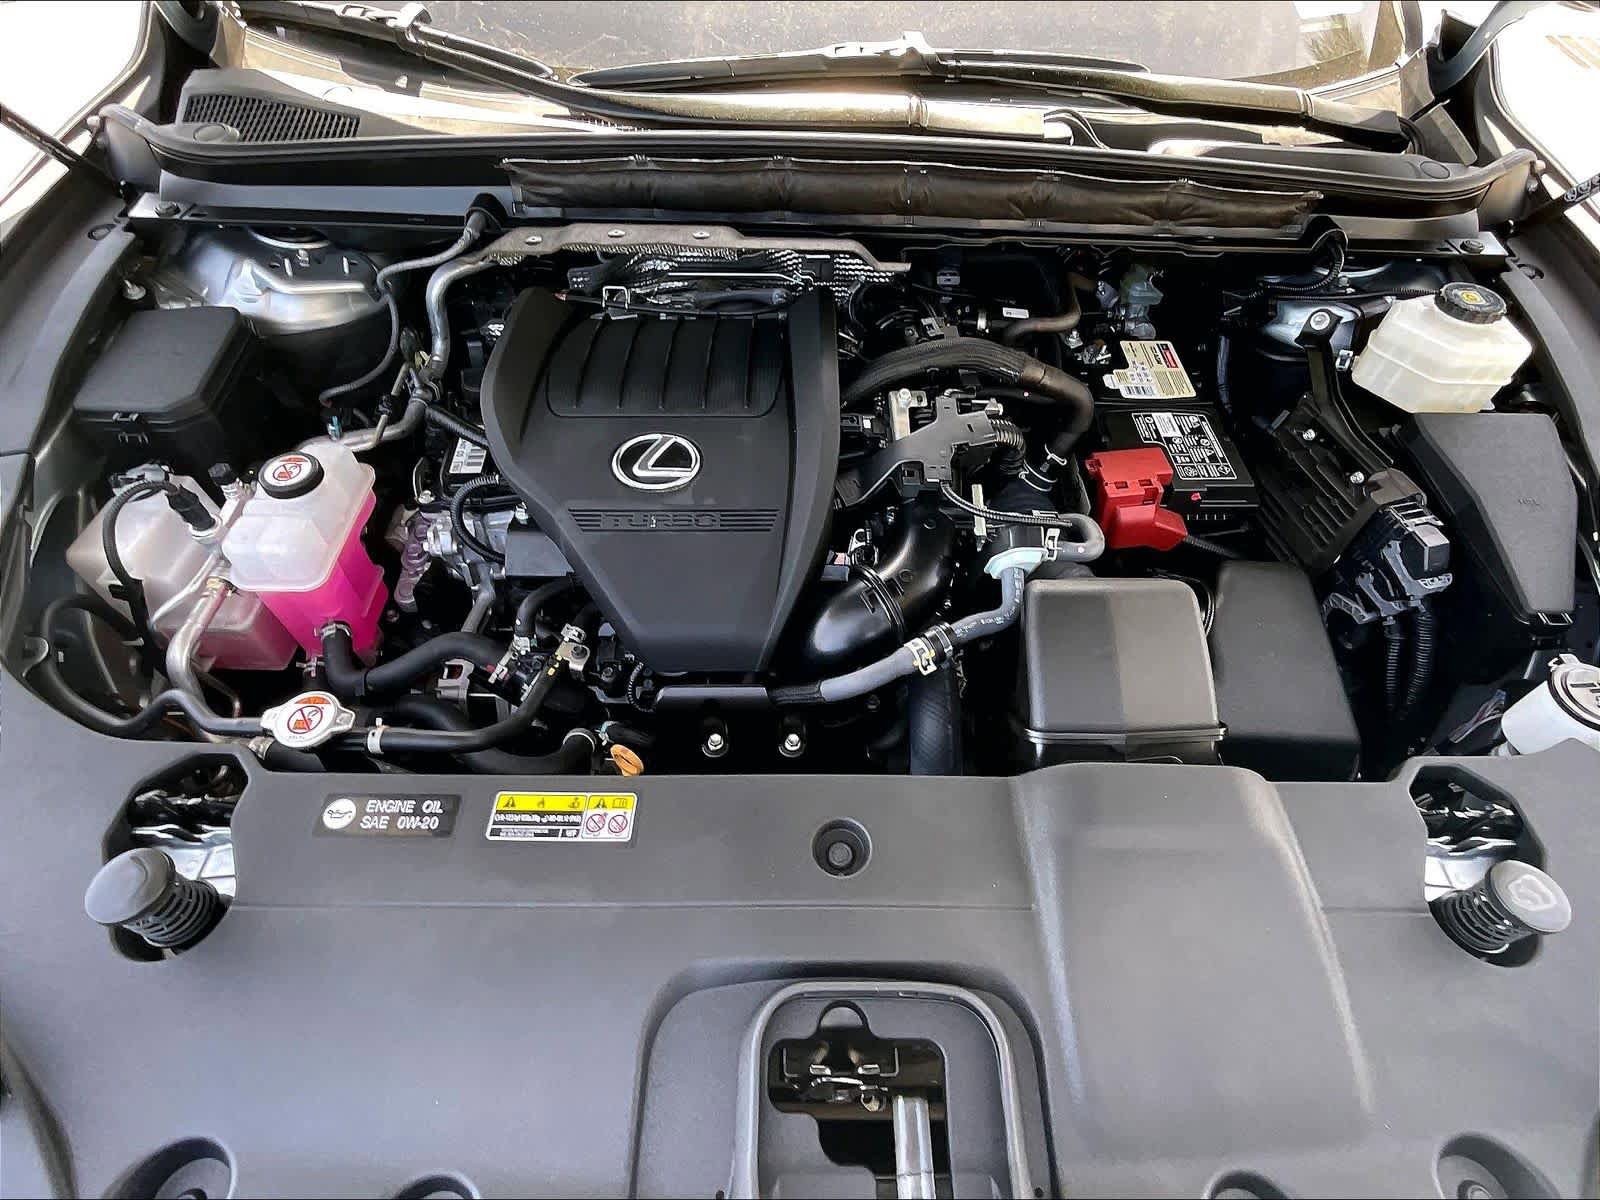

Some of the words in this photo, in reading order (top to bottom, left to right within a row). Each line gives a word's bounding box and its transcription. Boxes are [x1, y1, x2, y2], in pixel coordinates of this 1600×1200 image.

[600, 511, 720, 529] TURBO
[365, 799, 416, 814] ENGINE
[422, 800, 444, 814] OIL
[360, 816, 390, 830] SAE
[397, 816, 440, 830] 0W-20
